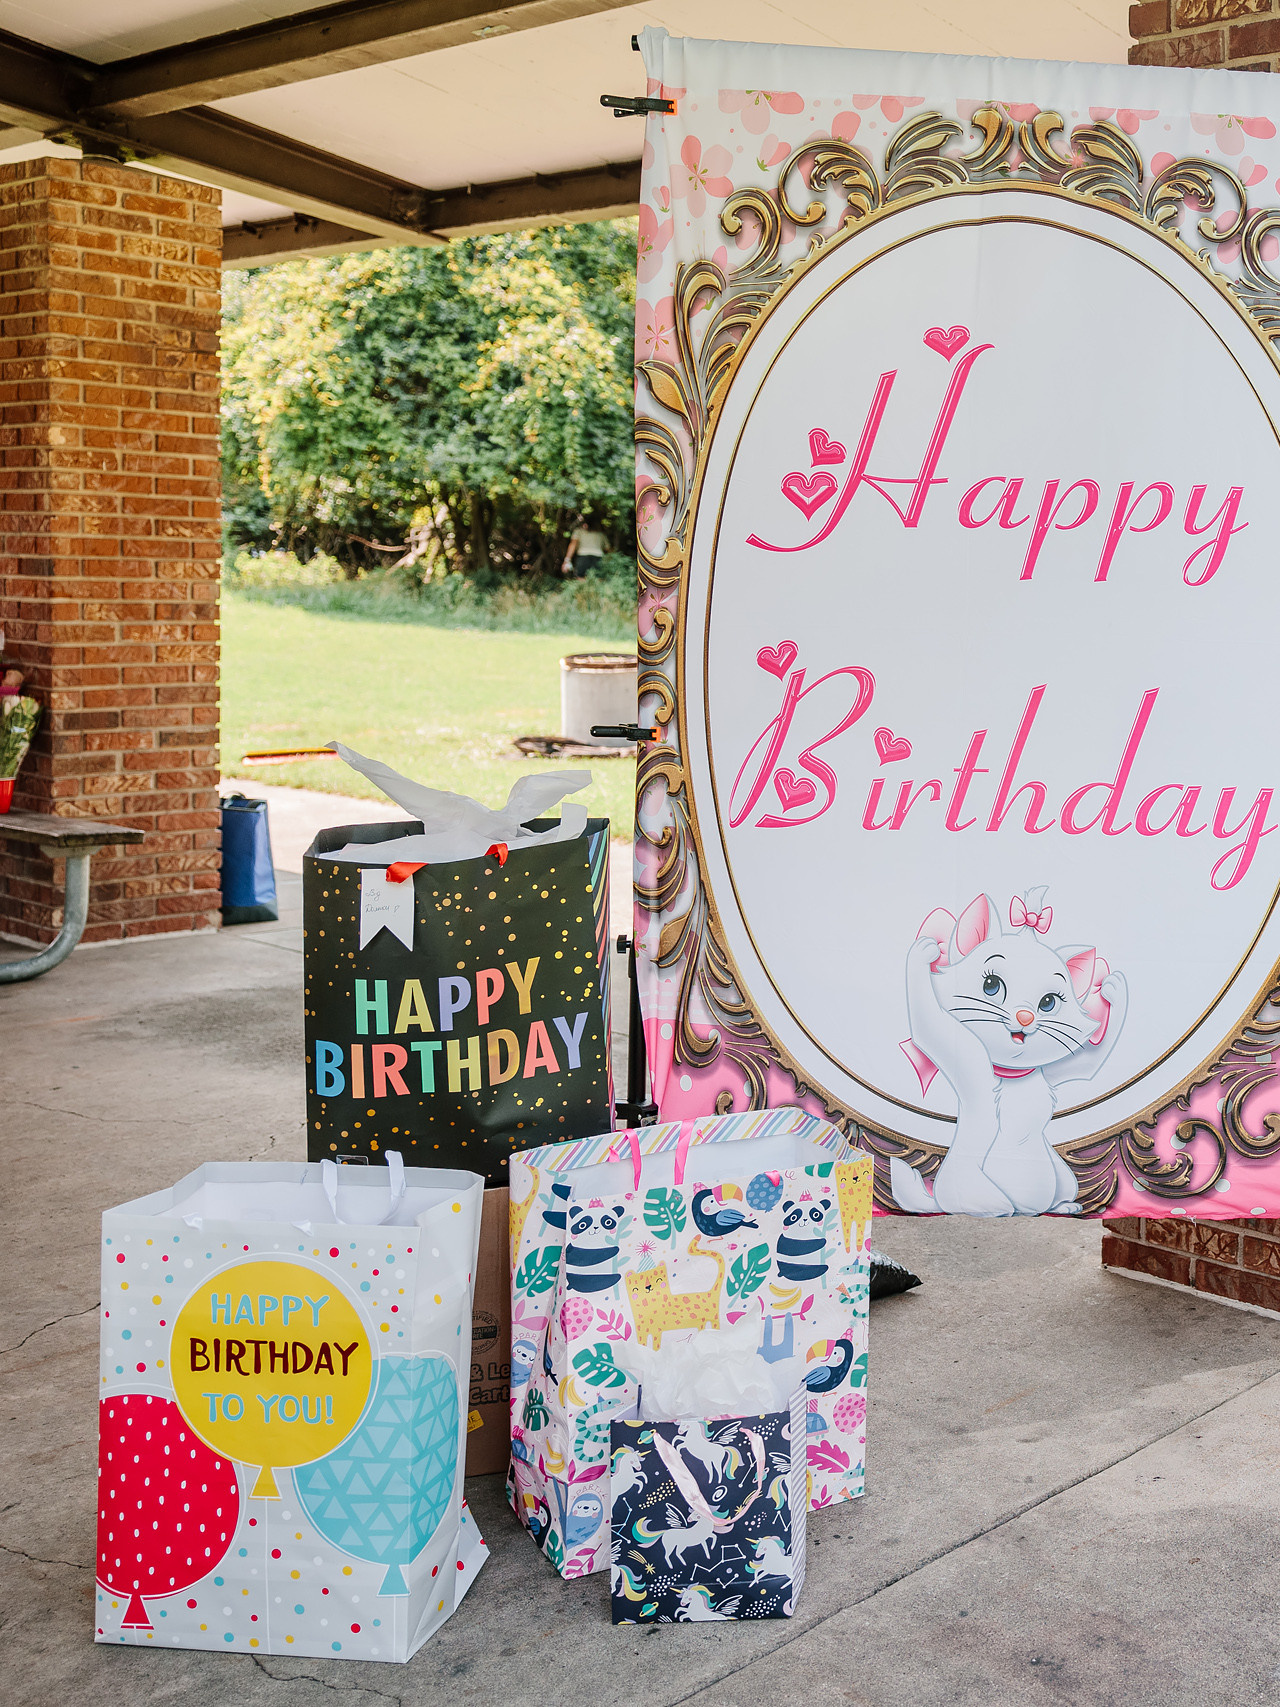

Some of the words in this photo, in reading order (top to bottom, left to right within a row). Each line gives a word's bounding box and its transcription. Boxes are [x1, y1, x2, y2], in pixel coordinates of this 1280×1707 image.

[745, 342, 1250, 587] Happy
[728, 666, 1279, 891] Birthday
[354, 956, 541, 1035] HAPPY
[315, 1011, 589, 1099] BIRTHDAY
[210, 1293, 331, 1326] HAPPY
[189, 1338, 360, 1376] BIRTHDAY
[202, 1393, 245, 1423] TO
[256, 1393, 335, 1424] YOU!
